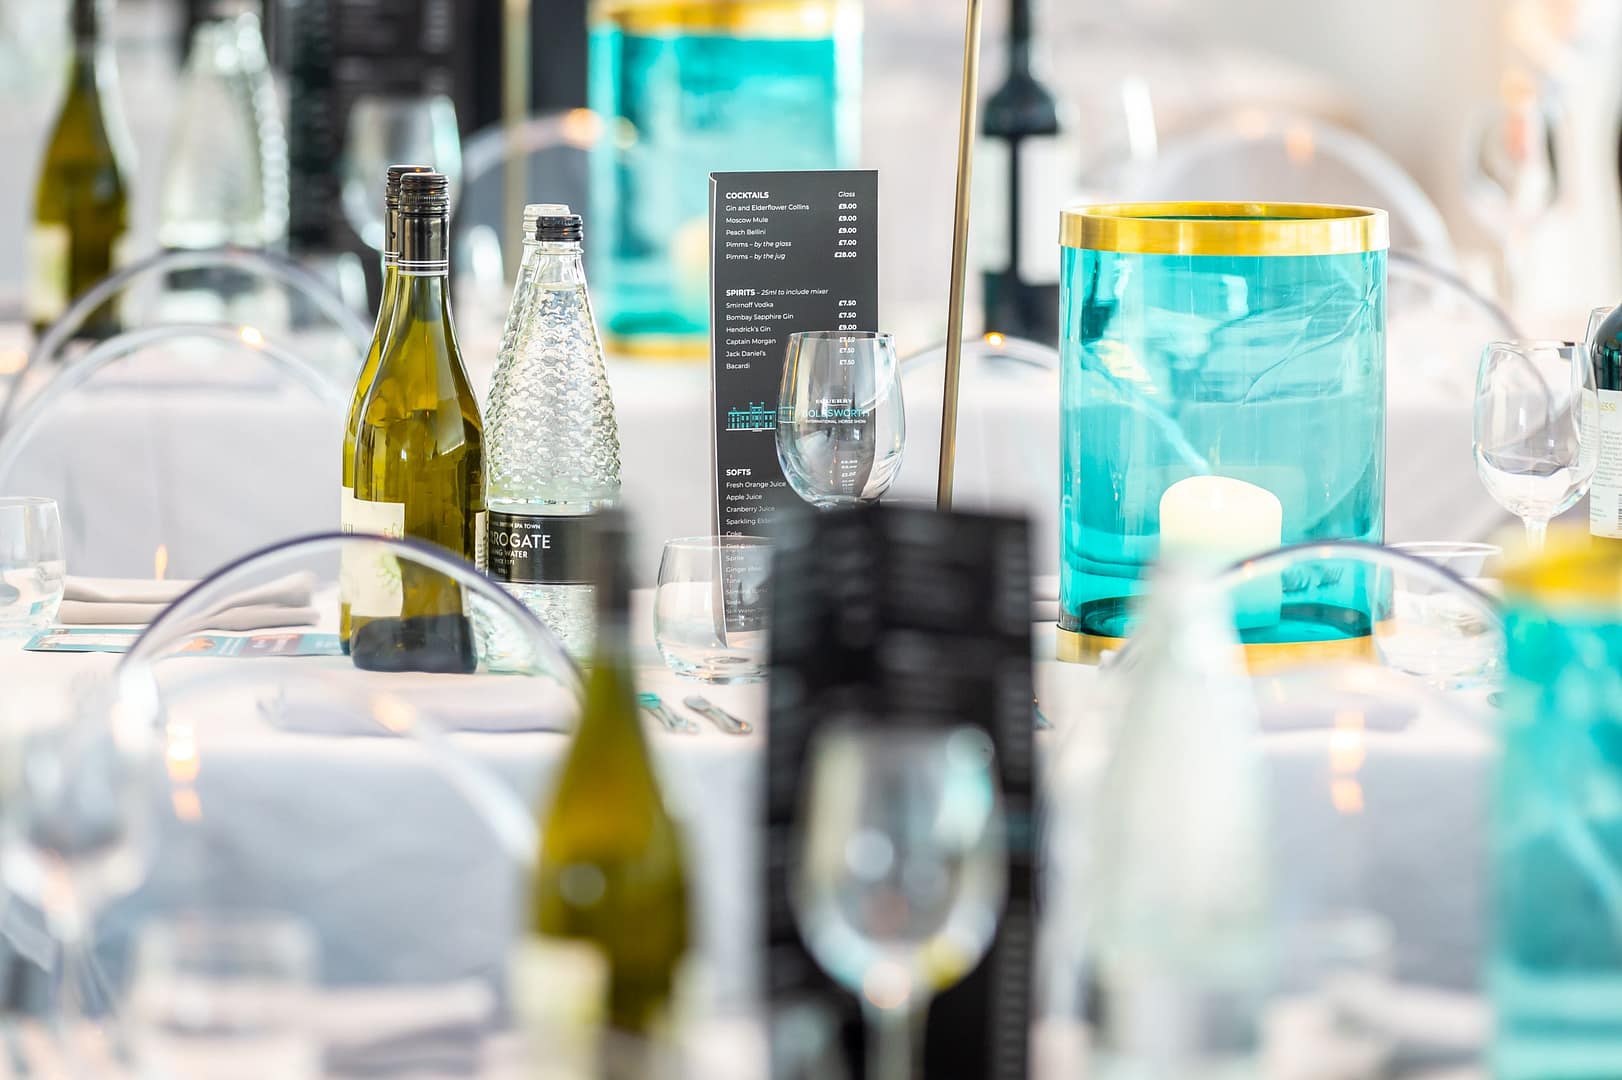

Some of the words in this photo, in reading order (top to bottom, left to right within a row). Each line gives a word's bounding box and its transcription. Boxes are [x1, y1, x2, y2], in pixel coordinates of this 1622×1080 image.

[725, 191, 770, 199] COCKTAILS
[753, 241, 763, 249] by
[775, 240, 792, 248] glass
[753, 253, 763, 261] by
[774, 252, 786, 261] jug
[726, 289, 756, 297] SPIRITS
[785, 288, 810, 296] include
[726, 314, 752, 322] Bombay
[753, 313, 782, 321] Sapphire
[726, 338, 750, 346] Captain
[726, 362, 750, 370] Bacardi
[745, 481, 769, 489] Orange
[769, 480, 787, 488] Juice
[726, 494, 745, 502] Apple
[726, 506, 758, 514] Cranberry
[726, 518, 756, 526] Sparkling
[504, 550, 528, 559] WATER
